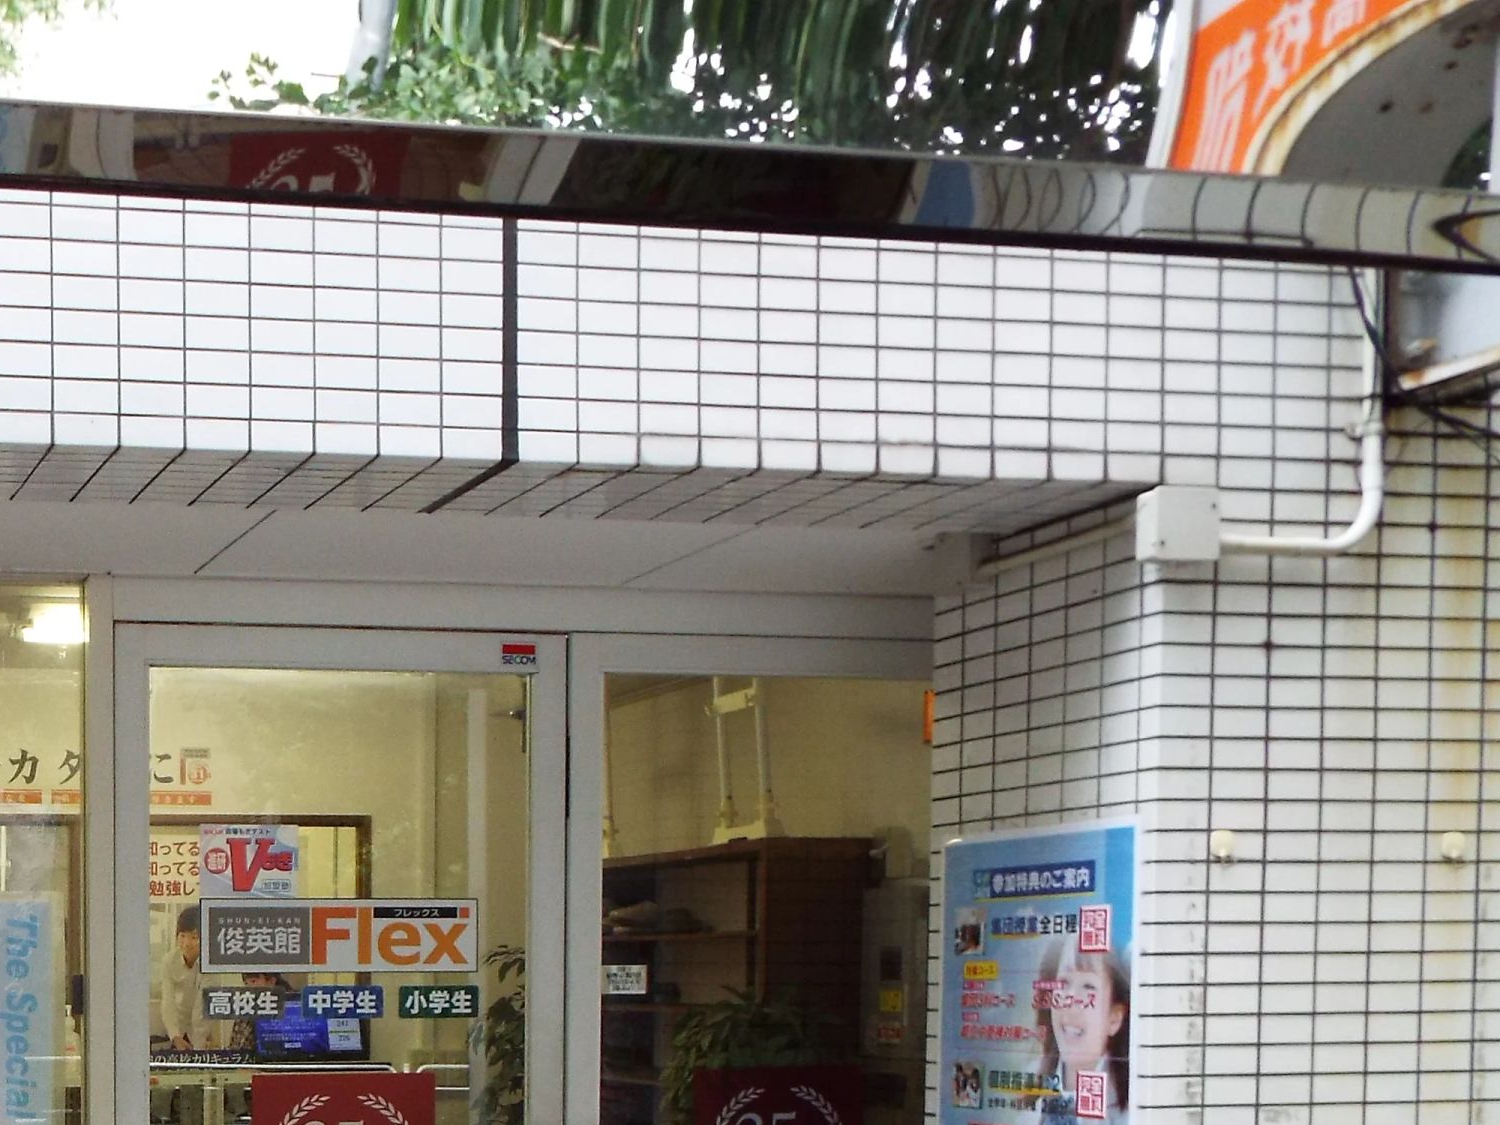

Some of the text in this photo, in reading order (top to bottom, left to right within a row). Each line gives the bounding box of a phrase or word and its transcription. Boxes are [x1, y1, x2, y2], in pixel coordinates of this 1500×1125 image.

[502, 655, 536, 665] SECOM
[393, 908, 440, 918] フレックス
[6, 913, 39, 979] The
[216, 907, 470, 965] 俊英館 Flex
[208, 990, 472, 1016] 高校生 中学生 小学生
